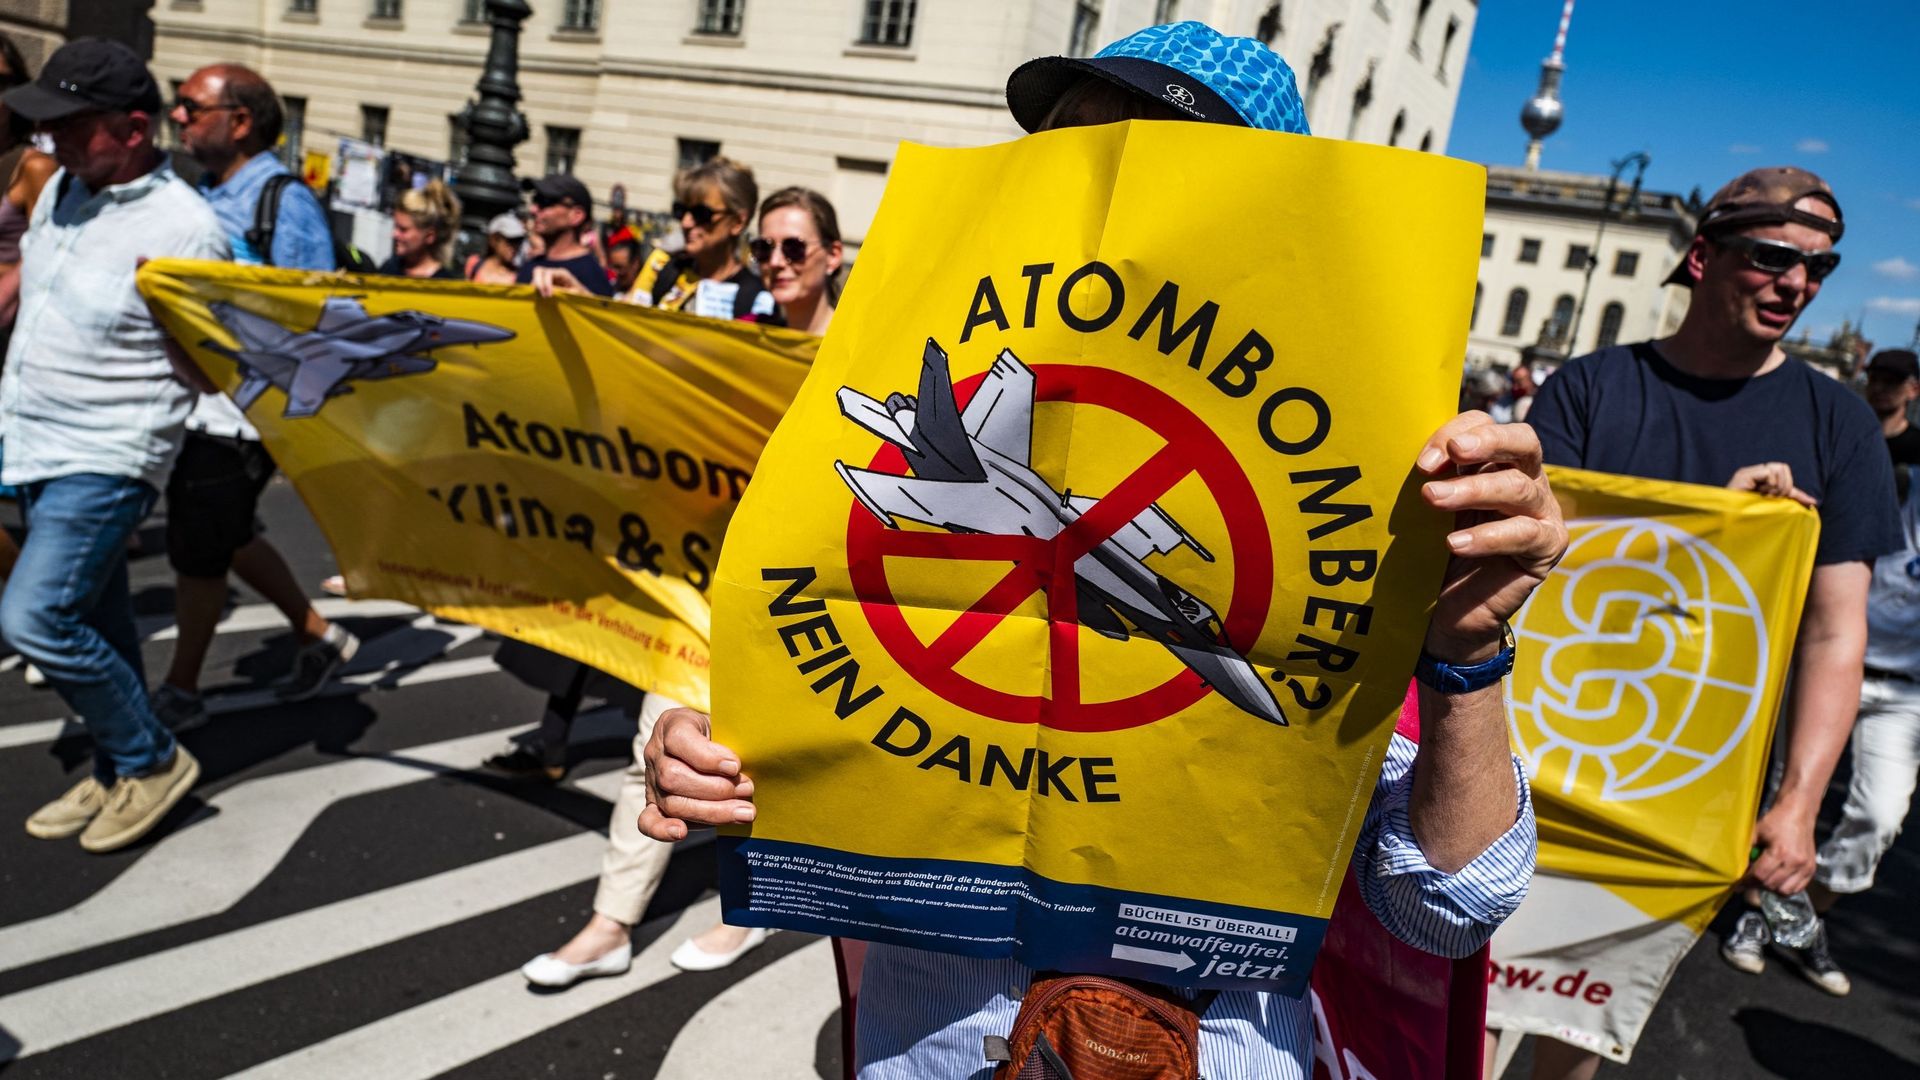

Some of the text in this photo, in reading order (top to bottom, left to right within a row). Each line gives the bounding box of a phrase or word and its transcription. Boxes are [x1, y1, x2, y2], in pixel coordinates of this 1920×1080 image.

[1162, 94, 1206, 119] Chaskee
[959, 261, 1378, 710] ATOMBOMBER?
[616, 513, 664, 577] &
[761, 567, 1121, 802] NEIN DANKE
[747, 859, 762, 867] Für
[781, 863, 808, 873] Abzug
[810, 867, 825, 875] der
[826, 870, 883, 885] Atombomben
[903, 879, 934, 889] Büchel
[954, 884, 968, 892] ein
[970, 885, 992, 895] Ende
[994, 888, 1009, 896] der
[1010, 889, 1052, 909] nuklearen
[1054, 903, 1096, 913] Teilhabe!
[764, 853, 790, 861] sagen
[793, 856, 815, 865] NEIN
[816, 861, 834, 869] zum
[836, 864, 857, 874] Kauf
[858, 869, 883, 877] neuer
[884, 871, 942, 881] Atombomber
[943, 873, 957, 882] für
[958, 876, 972, 884] die
[974, 878, 1030, 891] Bundeswehr.
[807, 883, 833, 892] unserem
[834, 888, 857, 896] Einsatz
[890, 895, 914, 903] Spende
[944, 901, 989, 911] Spendenkonto
[1124, 907, 1291, 940] BÜCHEL IST ÜBERALL!
[1115, 925, 1289, 960] atomwaffenfrei.
[1199, 955, 1286, 981] jetzt
